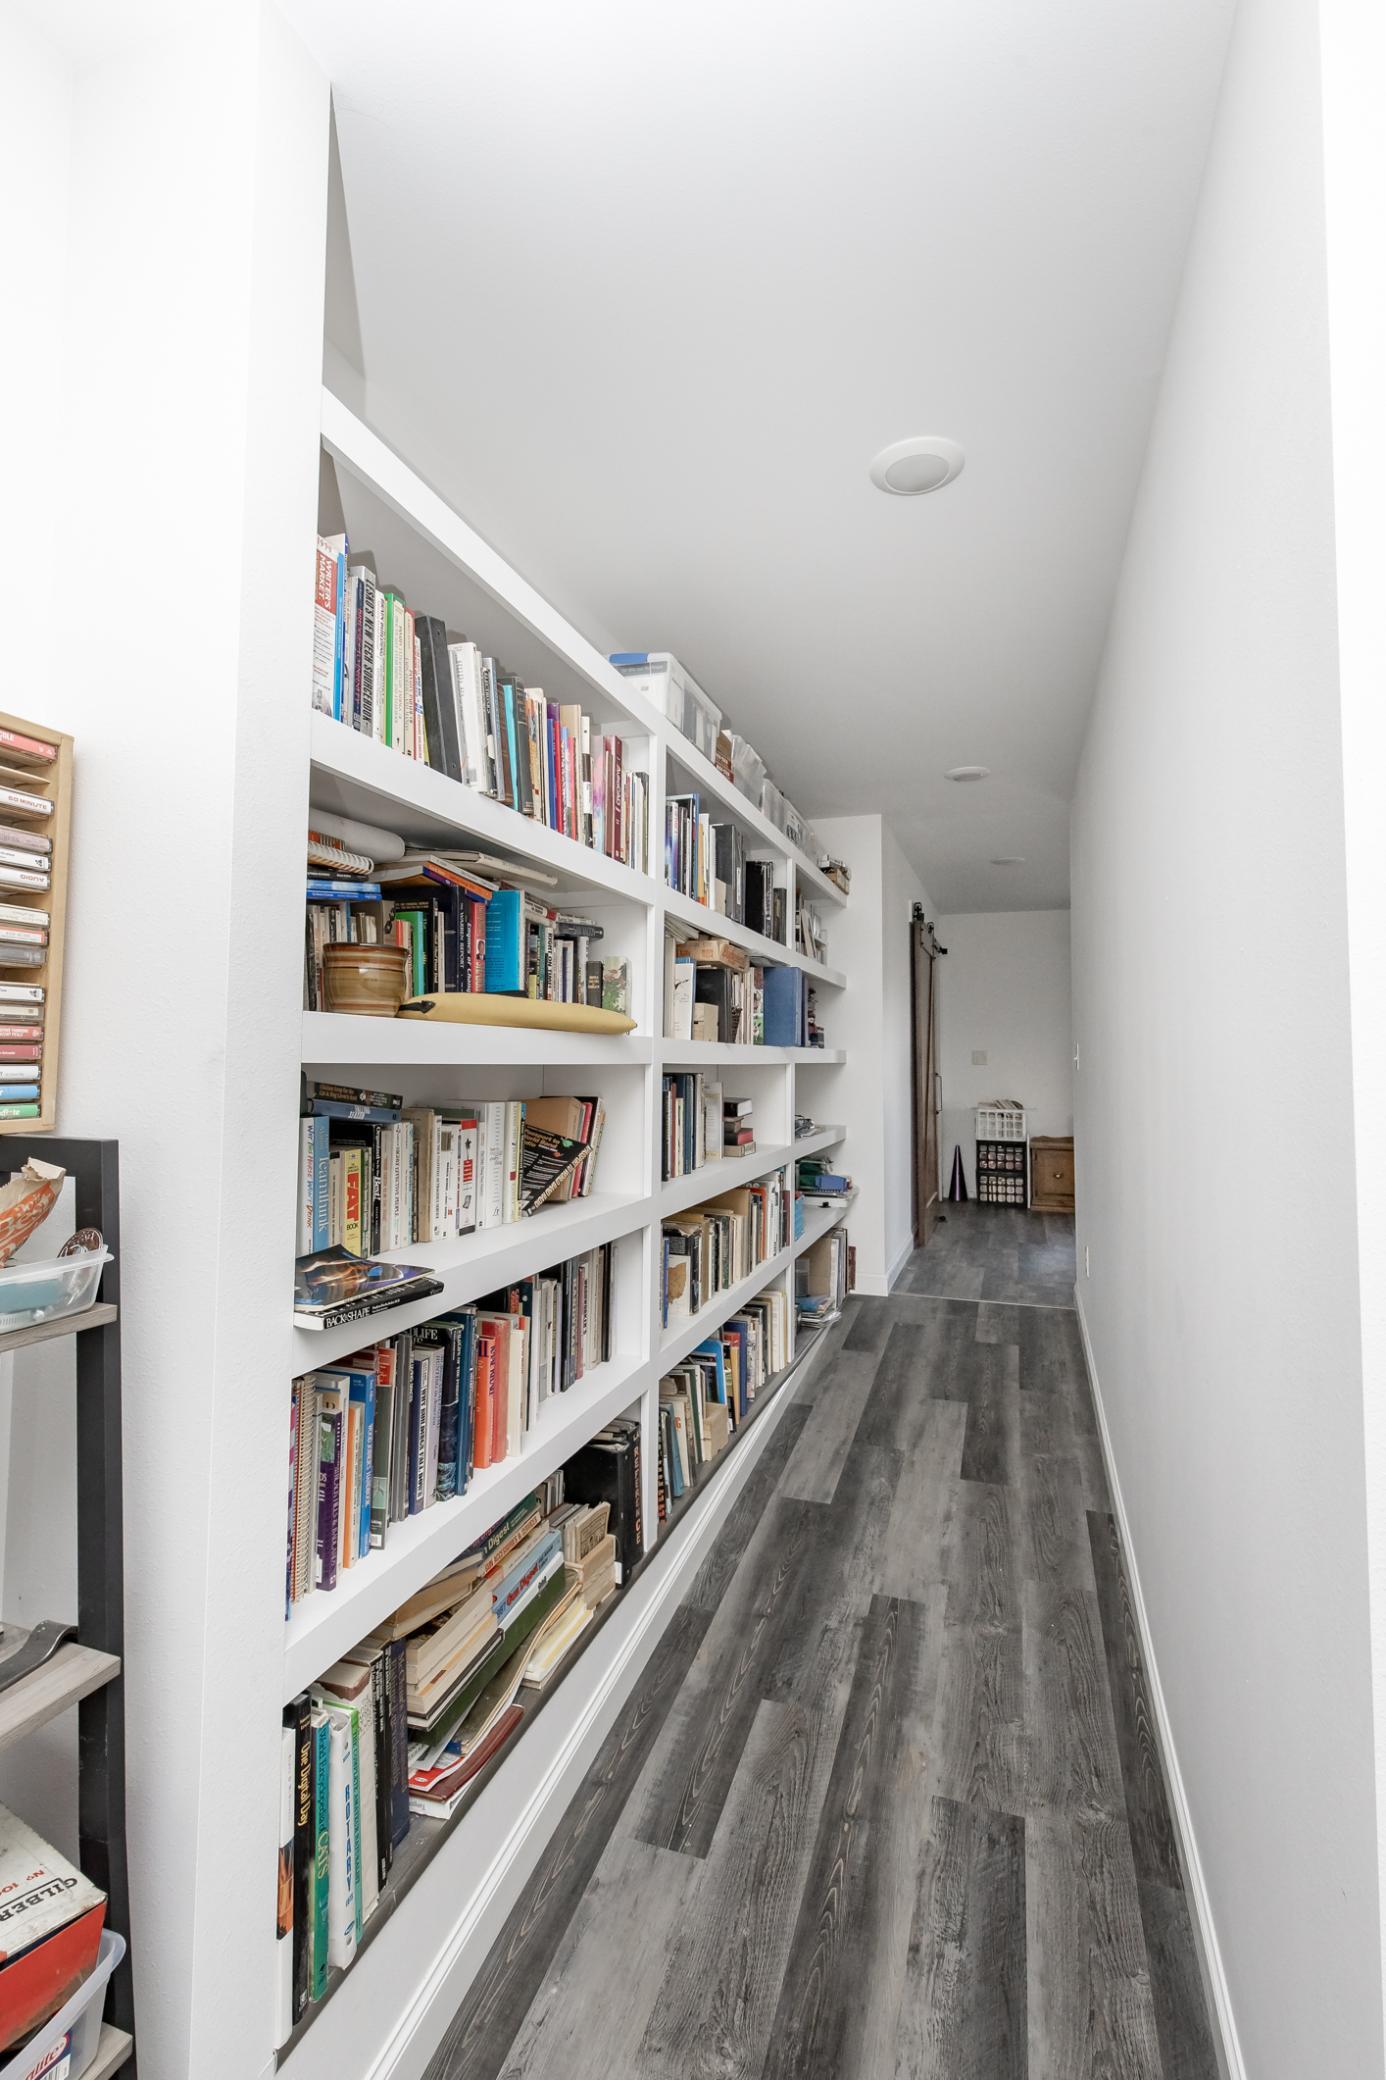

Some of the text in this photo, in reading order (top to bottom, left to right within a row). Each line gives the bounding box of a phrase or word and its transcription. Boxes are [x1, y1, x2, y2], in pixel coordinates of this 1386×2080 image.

[322, 559, 333, 609] WRITER'S
[363, 578, 375, 722] LESKO'S NEW TECH SOURCEBOOK
[346, 1171, 360, 1221] FAT
[325, 1314, 346, 1329] BACK
[347, 1306, 371, 1323] SHAPE
[318, 1729, 328, 1760] World
[297, 1743, 311, 1827] One Digital Day
[317, 1830, 329, 1880] CATS
